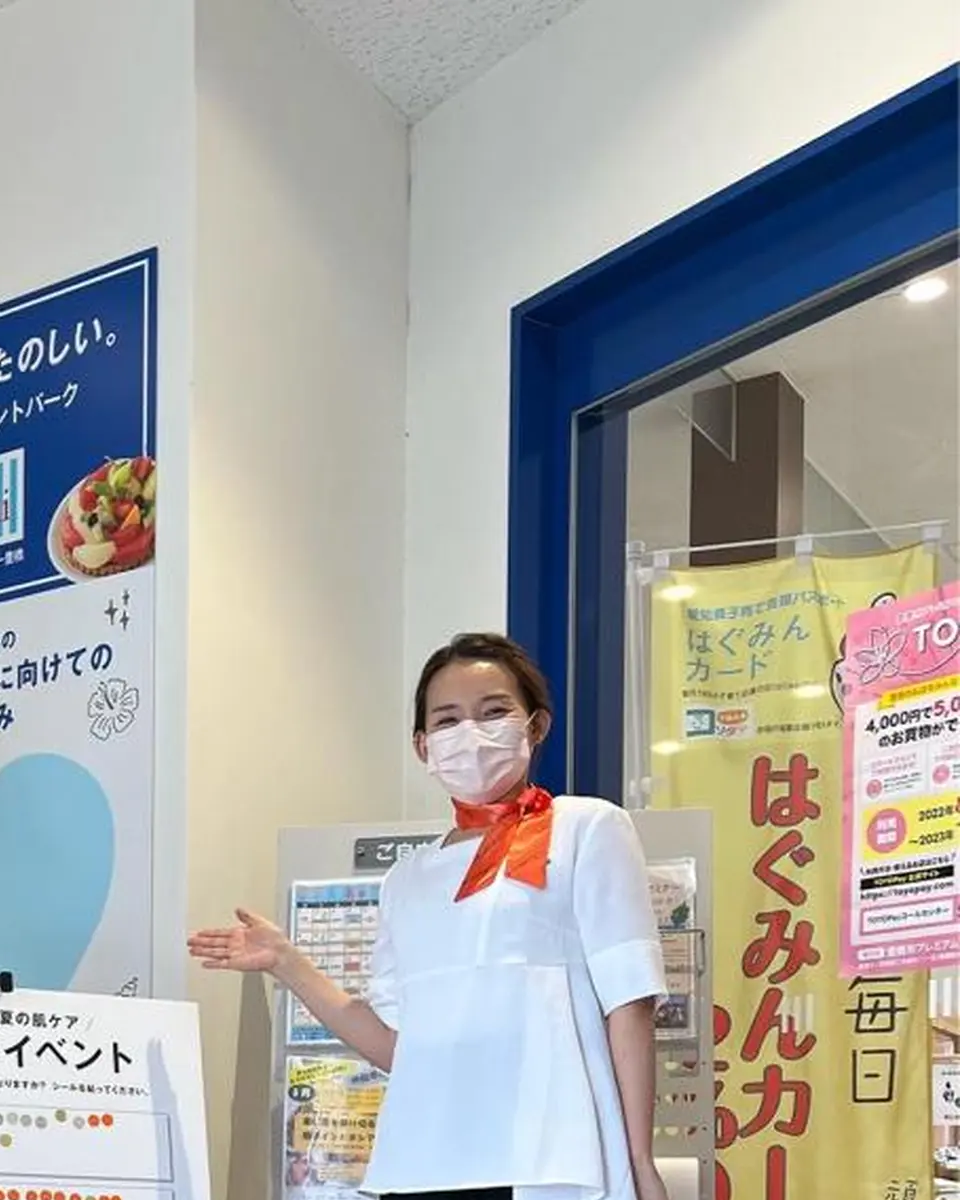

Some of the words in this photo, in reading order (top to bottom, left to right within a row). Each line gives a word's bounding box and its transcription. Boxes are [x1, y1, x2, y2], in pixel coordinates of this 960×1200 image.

[687, 614, 810, 656] はぐみん
[686, 651, 774, 683] カード
[845, 976, 909, 1103] 毎日
